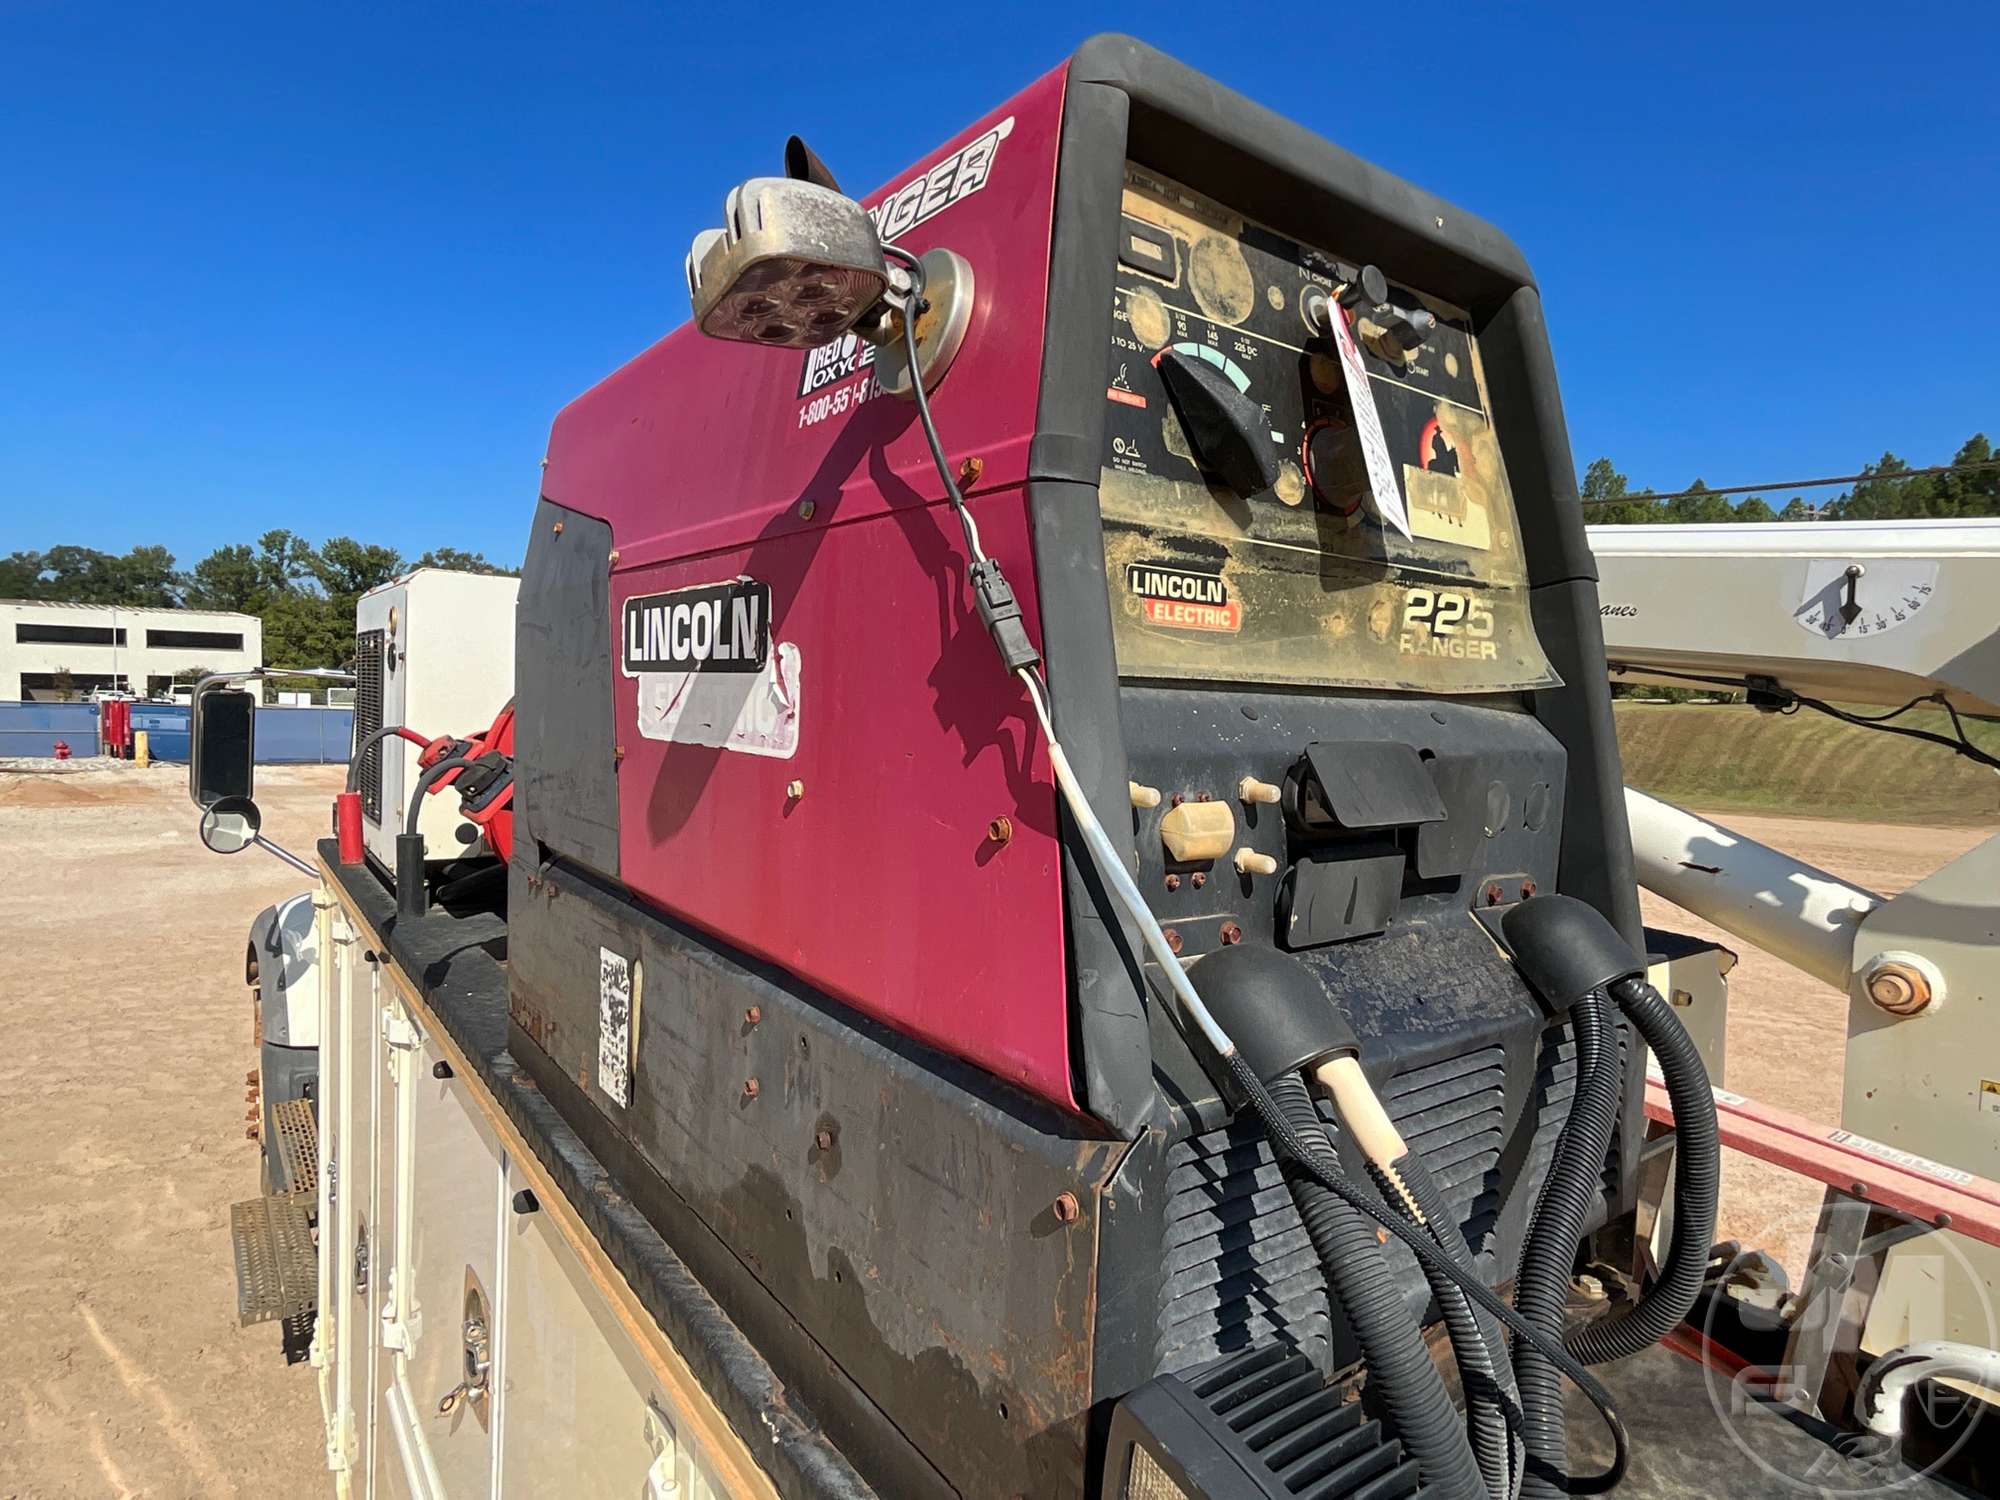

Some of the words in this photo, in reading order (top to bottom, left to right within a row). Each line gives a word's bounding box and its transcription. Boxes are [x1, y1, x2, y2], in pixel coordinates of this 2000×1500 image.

[1116, 337, 1126, 347] TO
[1132, 570, 1223, 603] LINCOLN
[629, 595, 759, 662] LINCOLN
[1154, 602, 1231, 627] ELECTRIC
[1402, 588, 1495, 639] 225
[1400, 633, 1498, 660] RANGER
